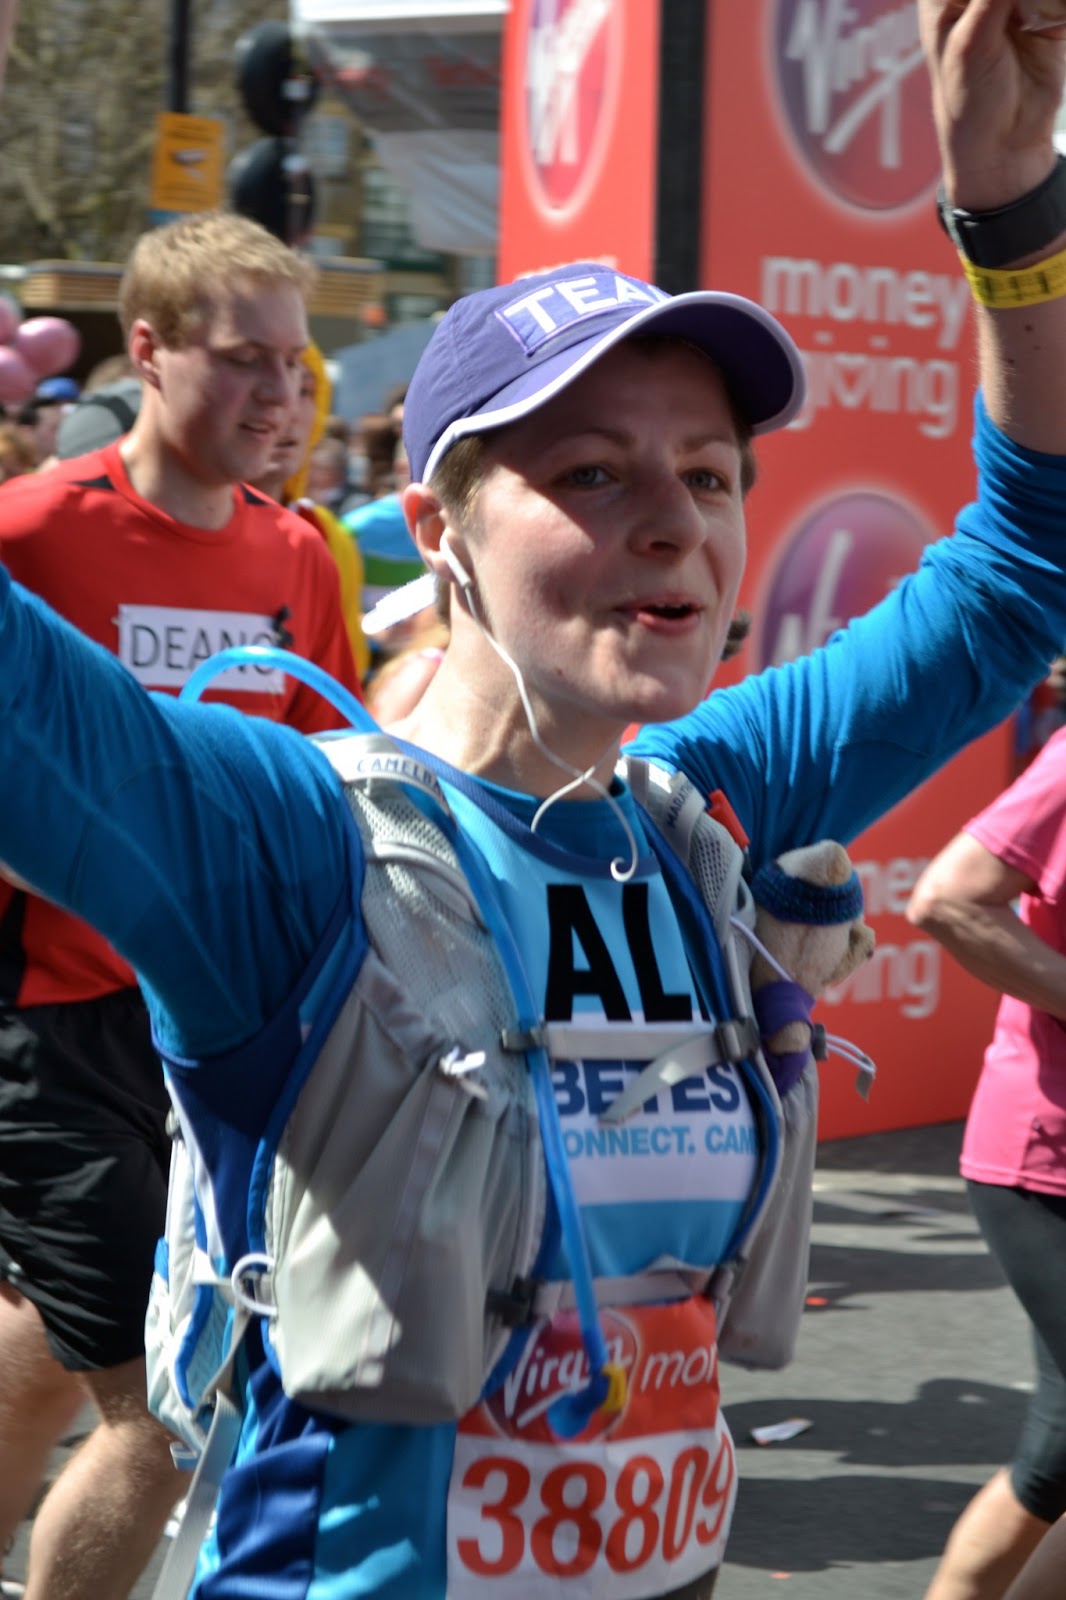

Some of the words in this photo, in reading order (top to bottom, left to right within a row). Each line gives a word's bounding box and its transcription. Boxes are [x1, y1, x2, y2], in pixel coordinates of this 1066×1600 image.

[761, 256, 968, 349] money
[544, 883, 709, 1022] AL
[504, 1318, 633, 1429] Virgn
[456, 1432, 734, 1578] 38809
